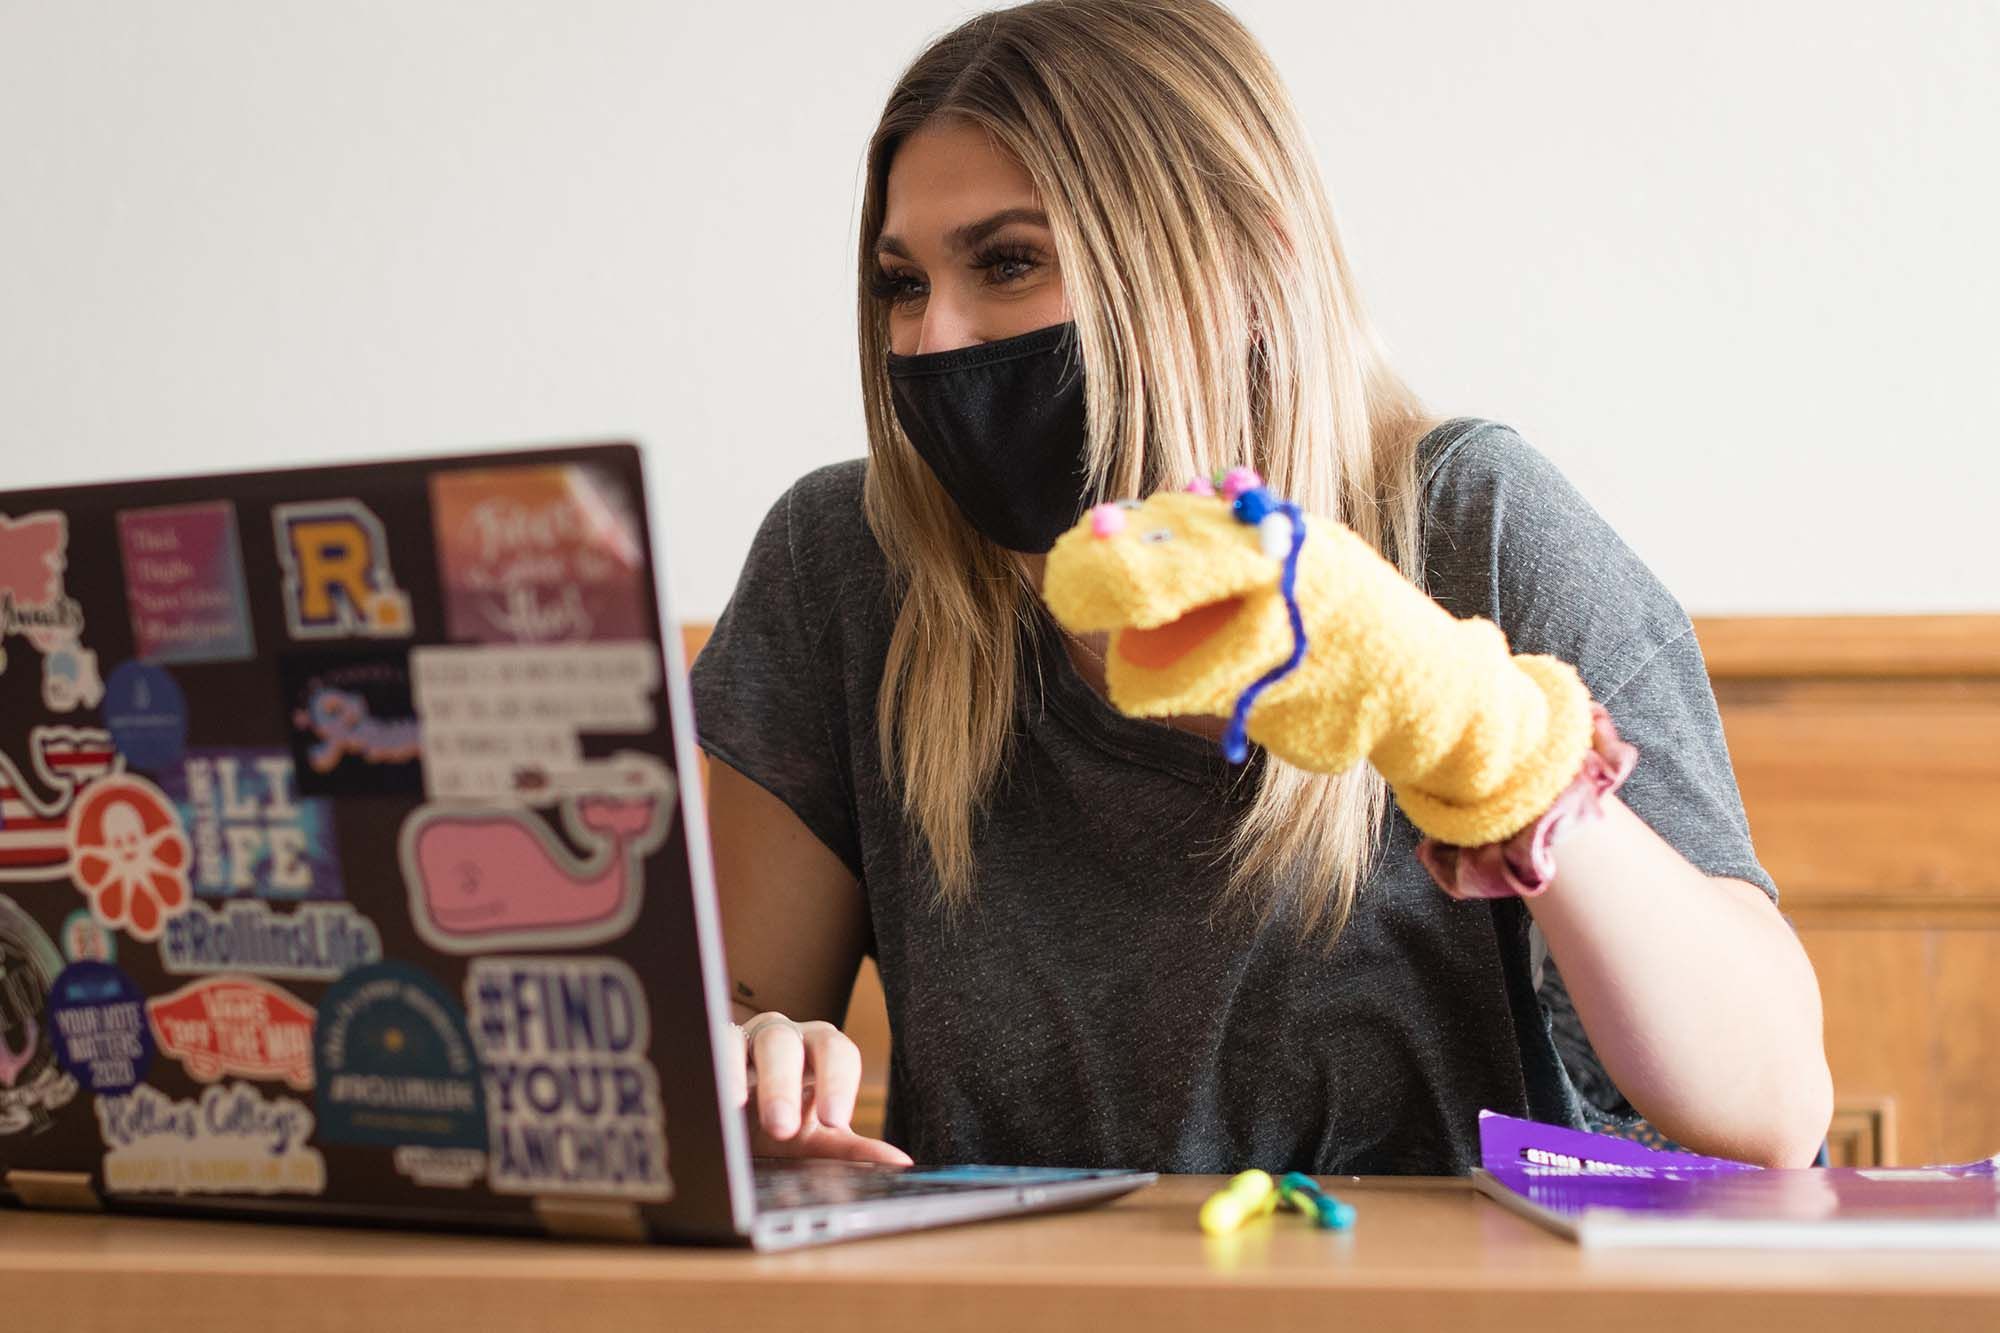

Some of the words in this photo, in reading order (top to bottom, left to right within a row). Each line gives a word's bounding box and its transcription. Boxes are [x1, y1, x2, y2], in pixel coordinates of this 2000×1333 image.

[285, 515, 370, 626] R
[479, 972, 636, 1052] #FIND
[483, 1062, 646, 1116] YOUR
